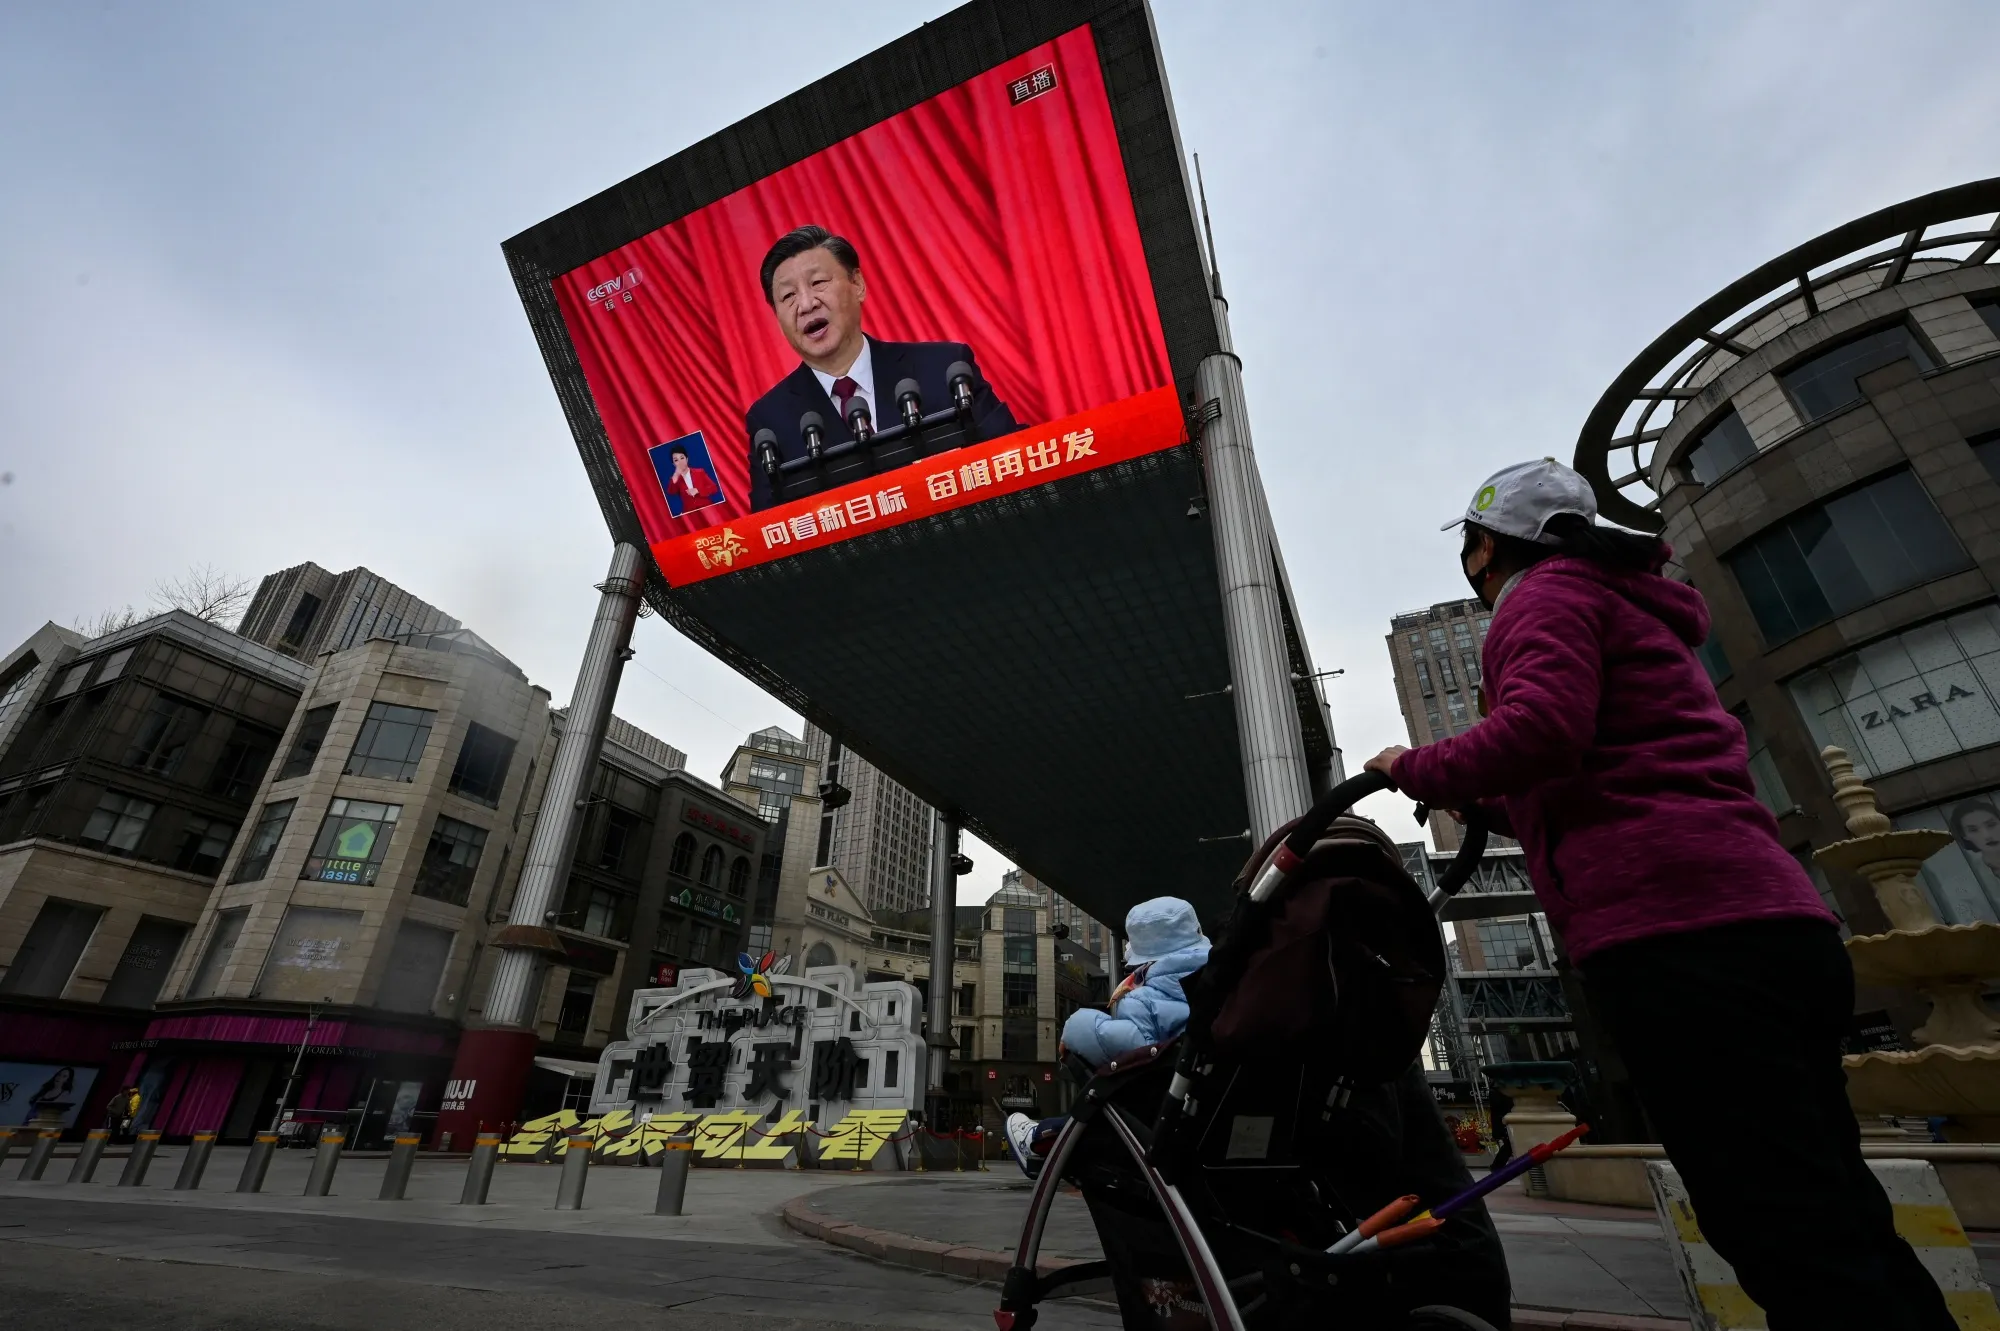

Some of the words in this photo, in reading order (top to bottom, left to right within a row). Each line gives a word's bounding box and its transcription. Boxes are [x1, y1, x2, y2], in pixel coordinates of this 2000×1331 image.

[1012, 69, 1051, 102] 直播
[587, 276, 620, 301] CCTV
[761, 485, 908, 549] 向着新目标
[926, 427, 1098, 501] 奋楫再出发
[695, 534, 723, 549] 2023
[1860, 684, 1975, 730] ZARA
[695, 1008, 736, 1030] THE
[740, 1005, 808, 1028] PLACE
[627, 1037, 863, 1100] 世贸天阶
[498, 1109, 908, 1161] 全北京向上看
